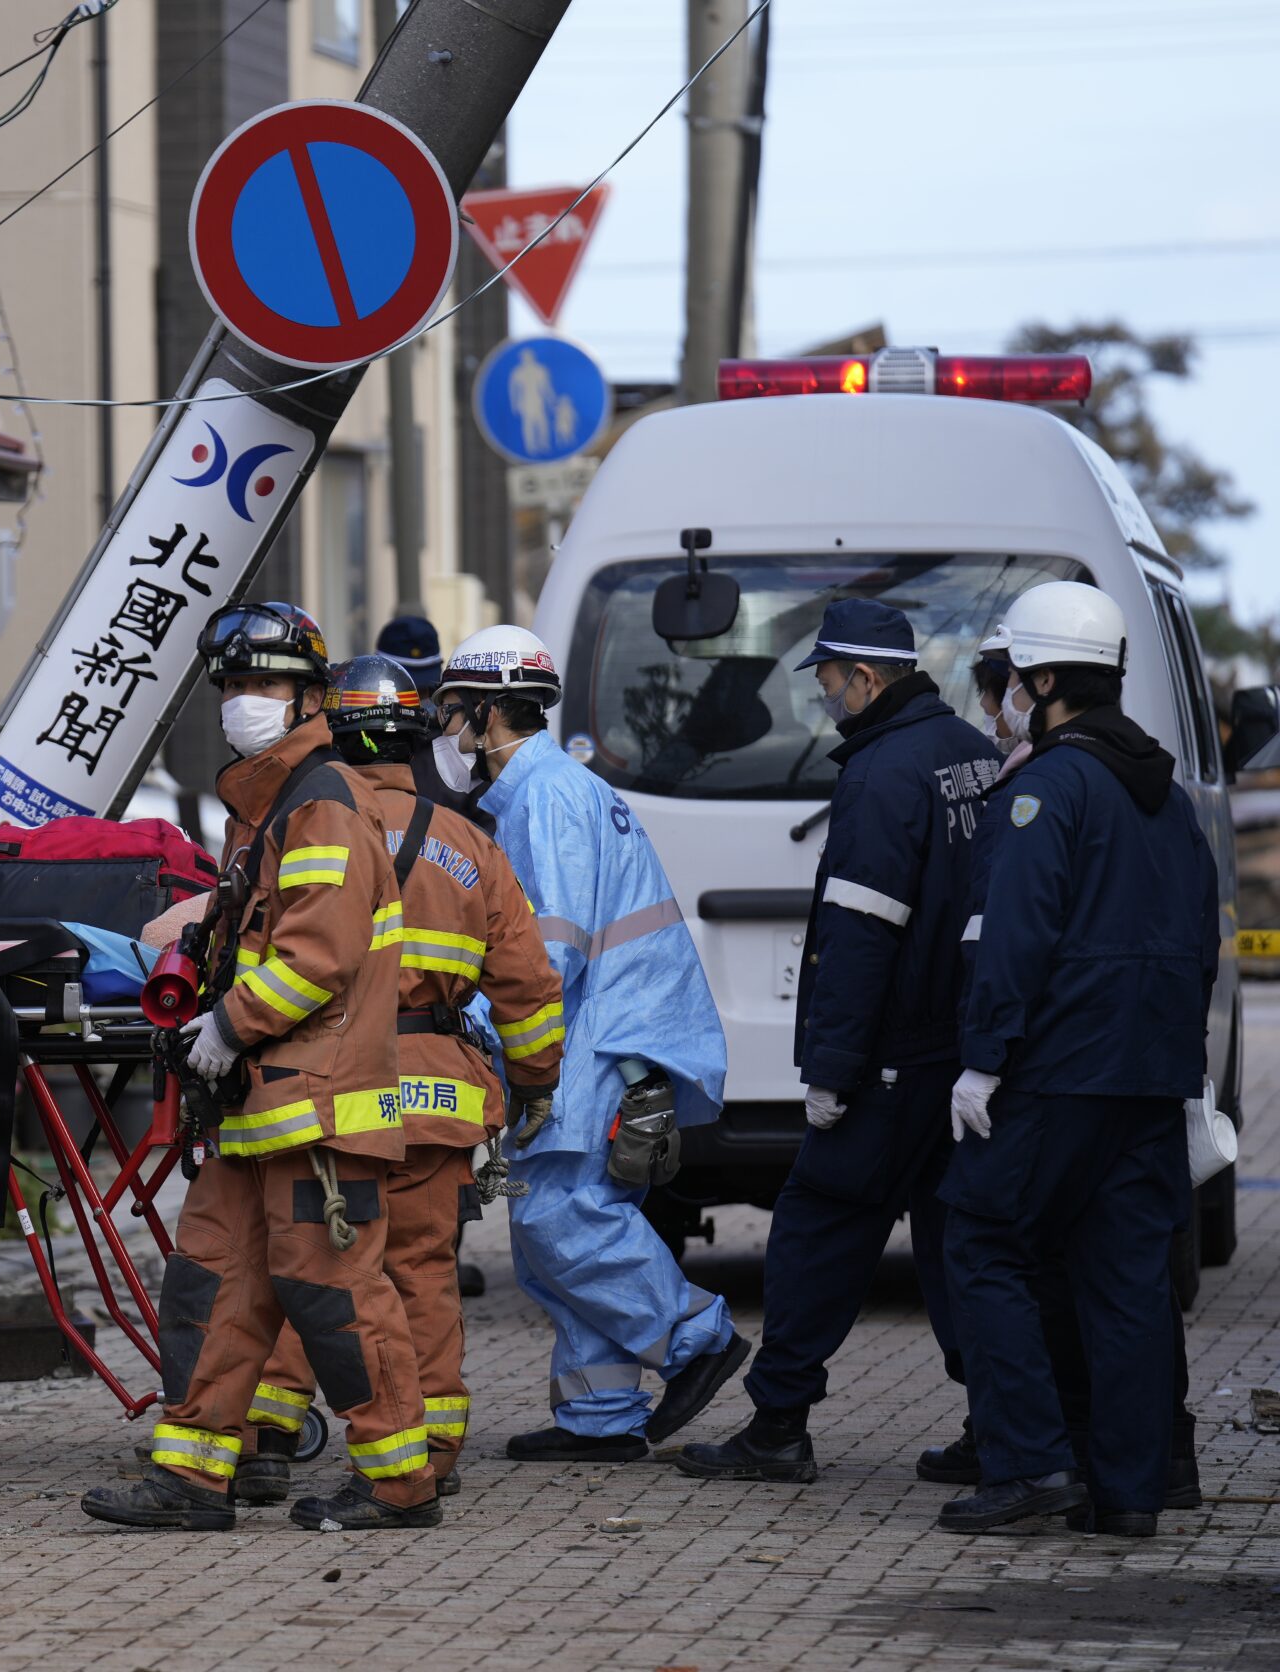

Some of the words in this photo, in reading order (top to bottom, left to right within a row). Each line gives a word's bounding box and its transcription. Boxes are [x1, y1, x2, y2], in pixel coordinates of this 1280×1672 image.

[35, 522, 220, 777] 北國新聞
[452, 650, 519, 669] 大阪市消防局
[1, 790, 55, 826] お申込み
[386, 830, 404, 855] RE
[418, 835, 480, 891] BUREAU
[378, 1093, 400, 1122] 堺
[400, 1081, 457, 1112] 防局
